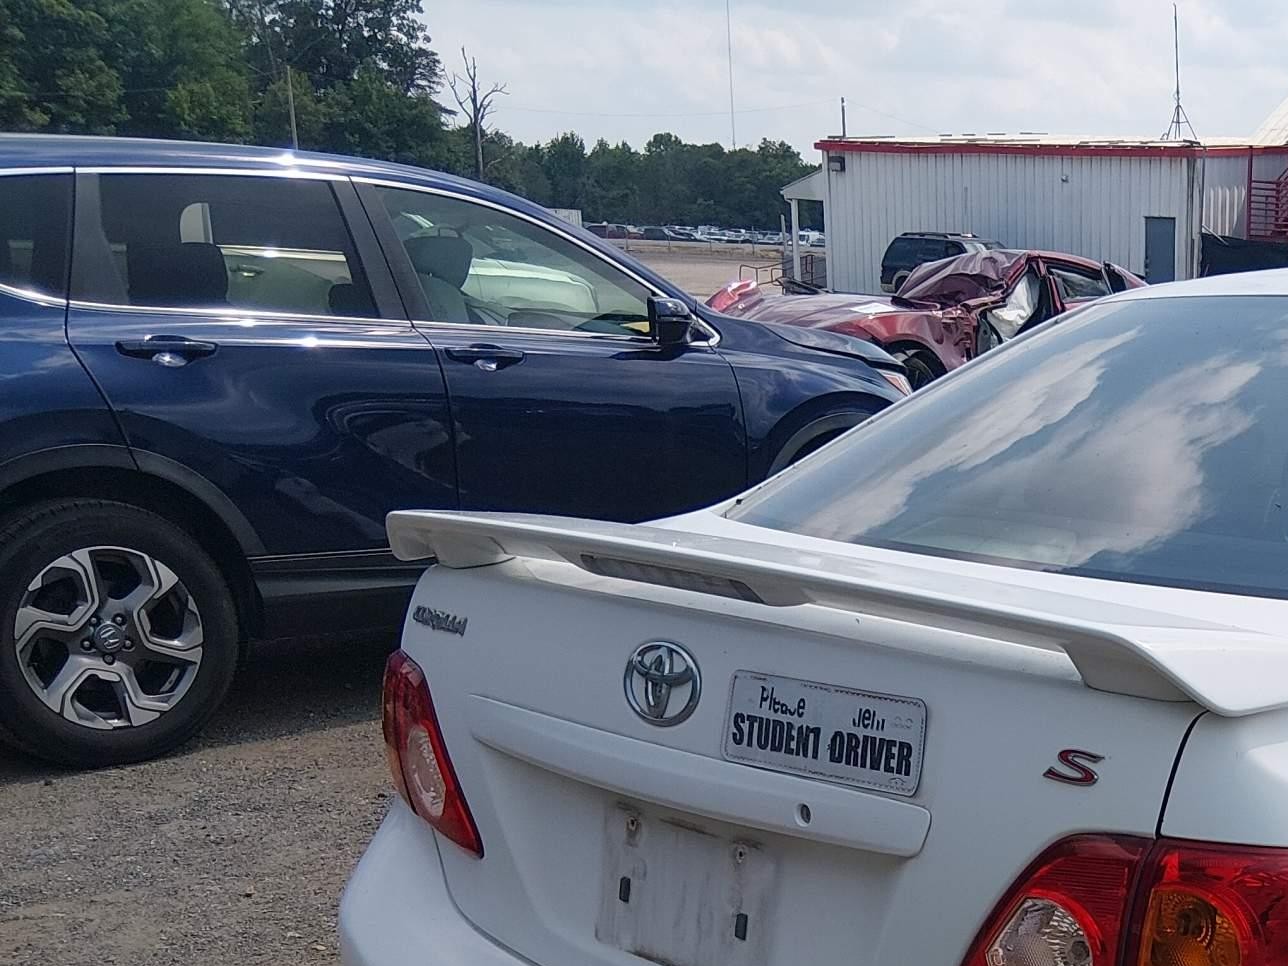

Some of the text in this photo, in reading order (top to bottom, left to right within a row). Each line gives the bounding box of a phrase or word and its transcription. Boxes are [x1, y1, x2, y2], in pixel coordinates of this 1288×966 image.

[731, 711, 822, 761] STUDENT
[828, 730, 913, 777] DRIVER
[1042, 749, 1106, 788] S
